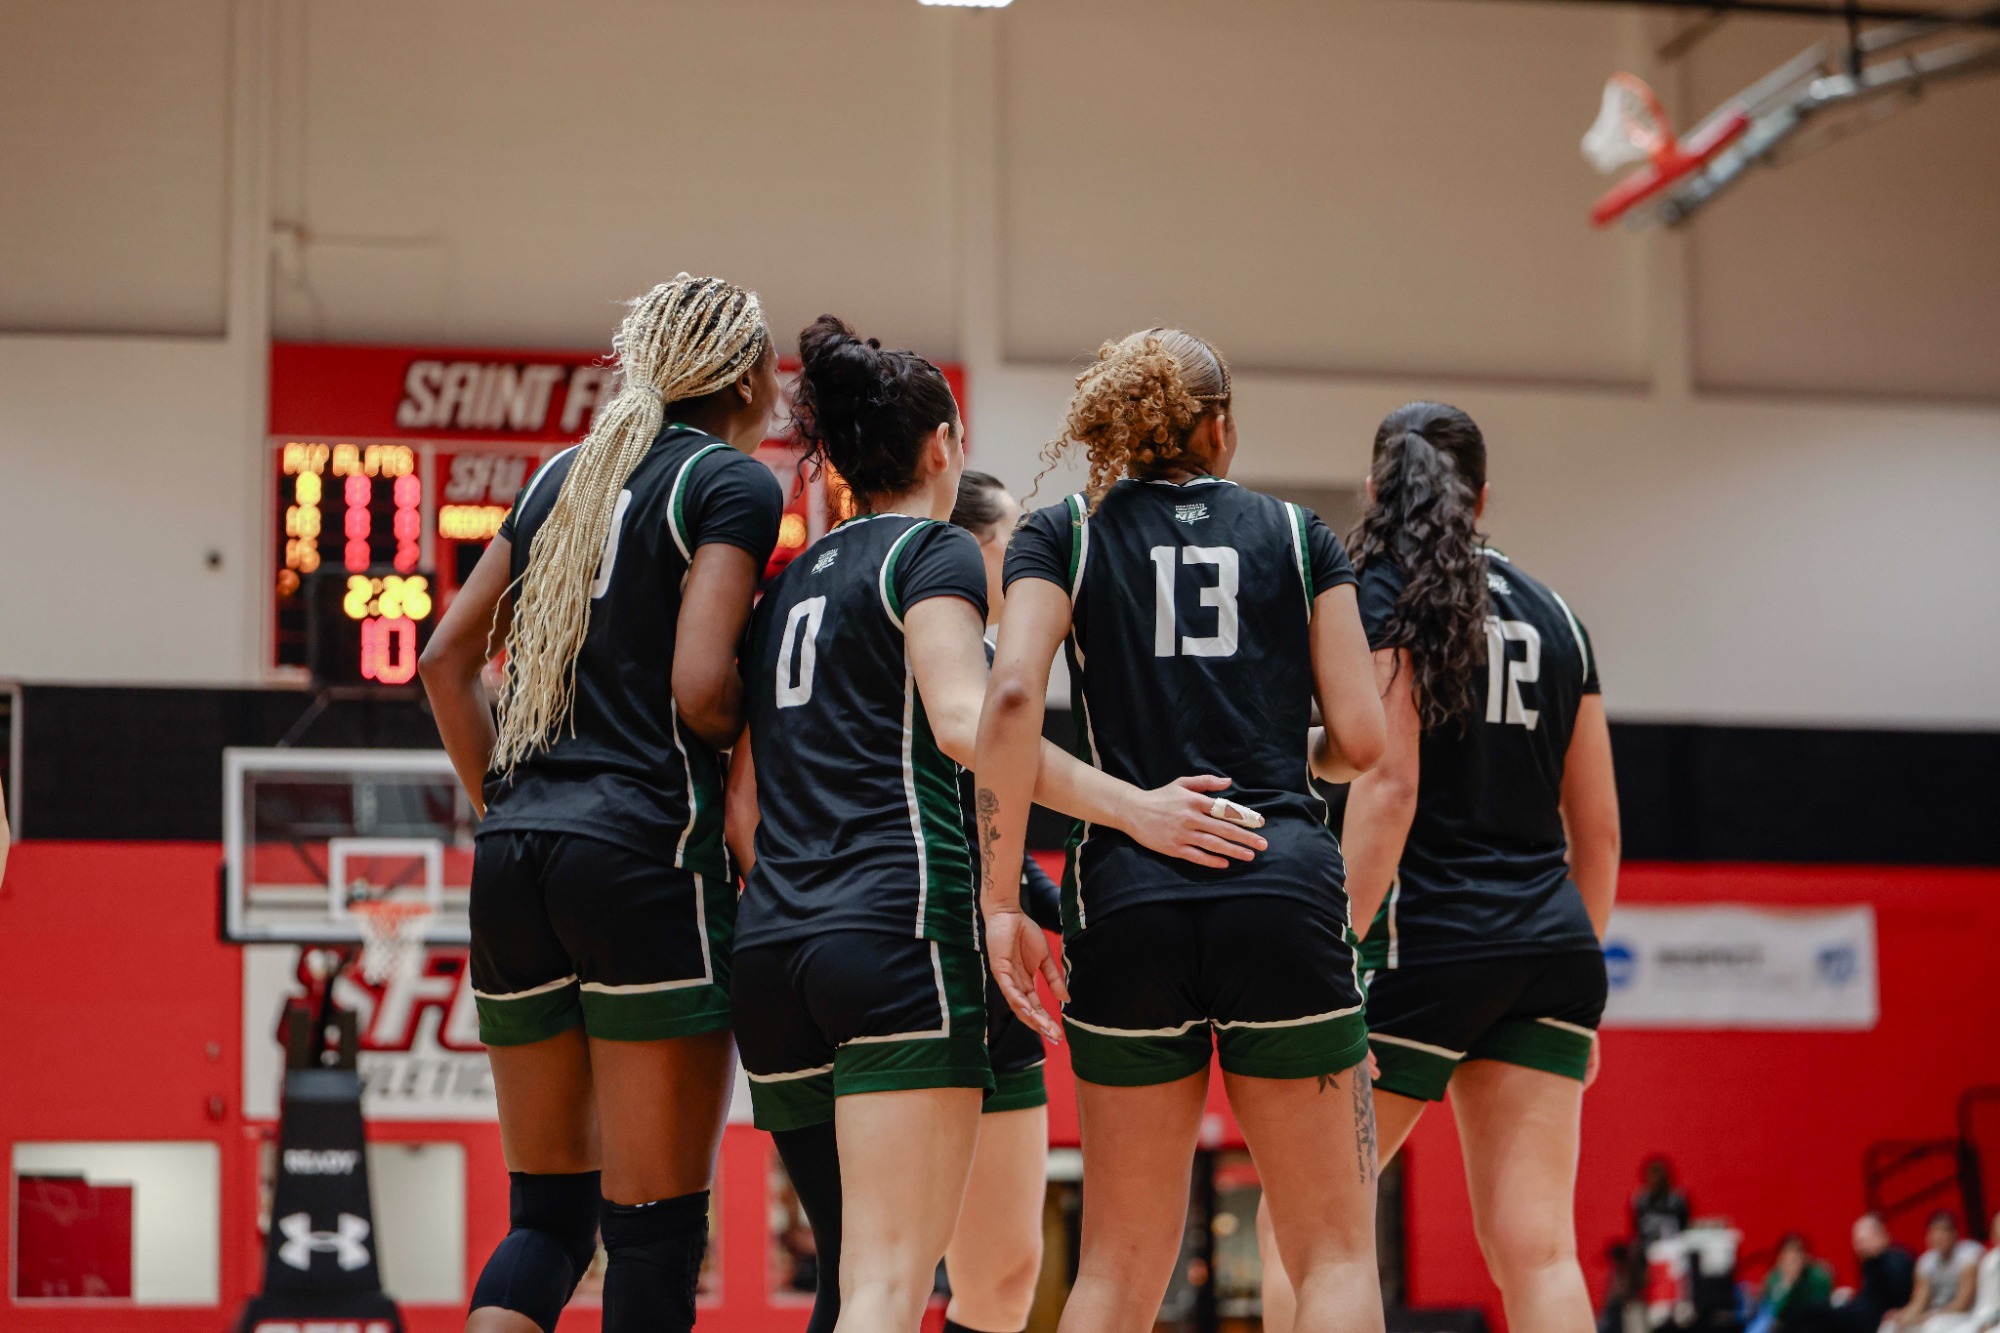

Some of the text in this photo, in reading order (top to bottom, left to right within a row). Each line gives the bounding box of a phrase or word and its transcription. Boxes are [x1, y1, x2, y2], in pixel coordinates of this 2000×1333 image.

[397, 360, 561, 430] SAINT
[445, 456, 527, 502] SFU
[1150, 545, 1240, 658] 13
[361, 614, 417, 684] 10
[775, 595, 827, 709] 0
[1482, 614, 1542, 731] 12
